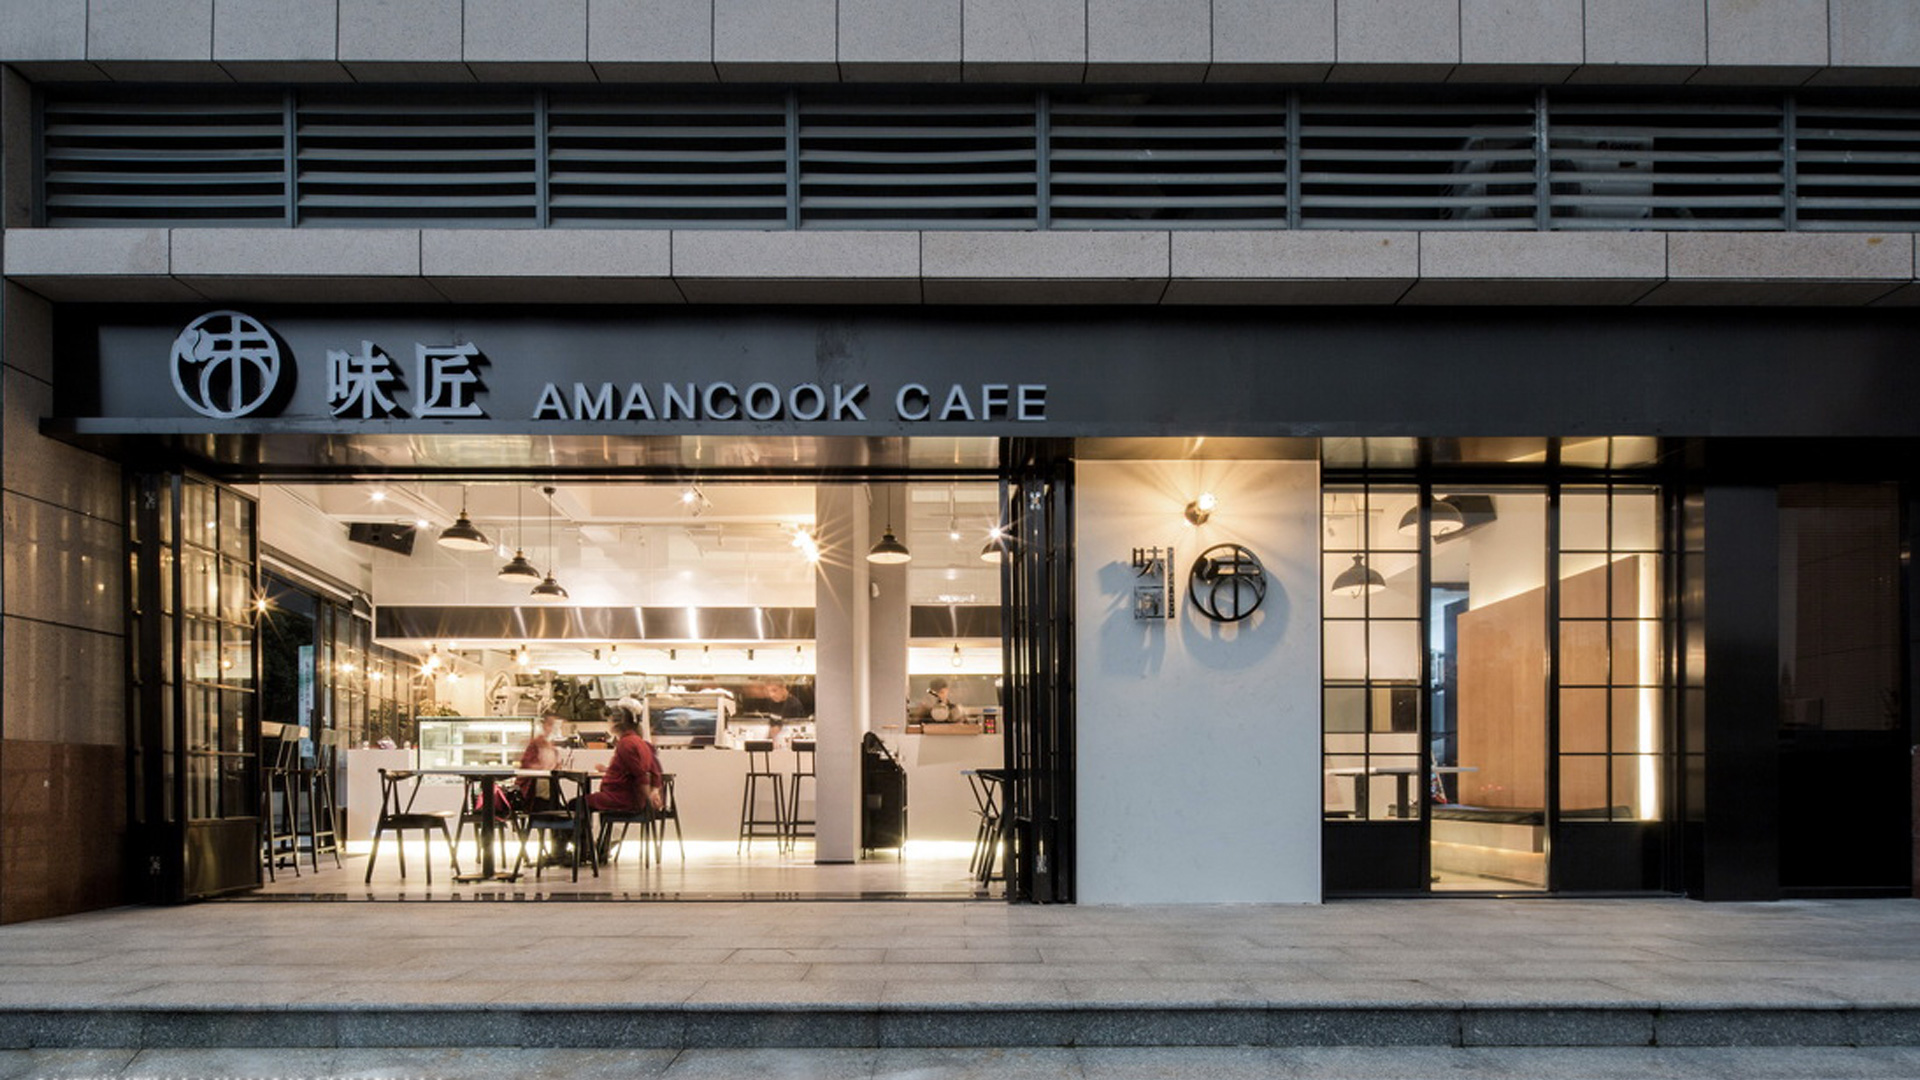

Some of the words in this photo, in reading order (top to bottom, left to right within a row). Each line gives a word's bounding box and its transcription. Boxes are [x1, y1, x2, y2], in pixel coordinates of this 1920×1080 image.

[326, 340, 484, 419] 味匠
[532, 382, 867, 421] AMANCOOK
[895, 382, 1047, 421] CAFE
